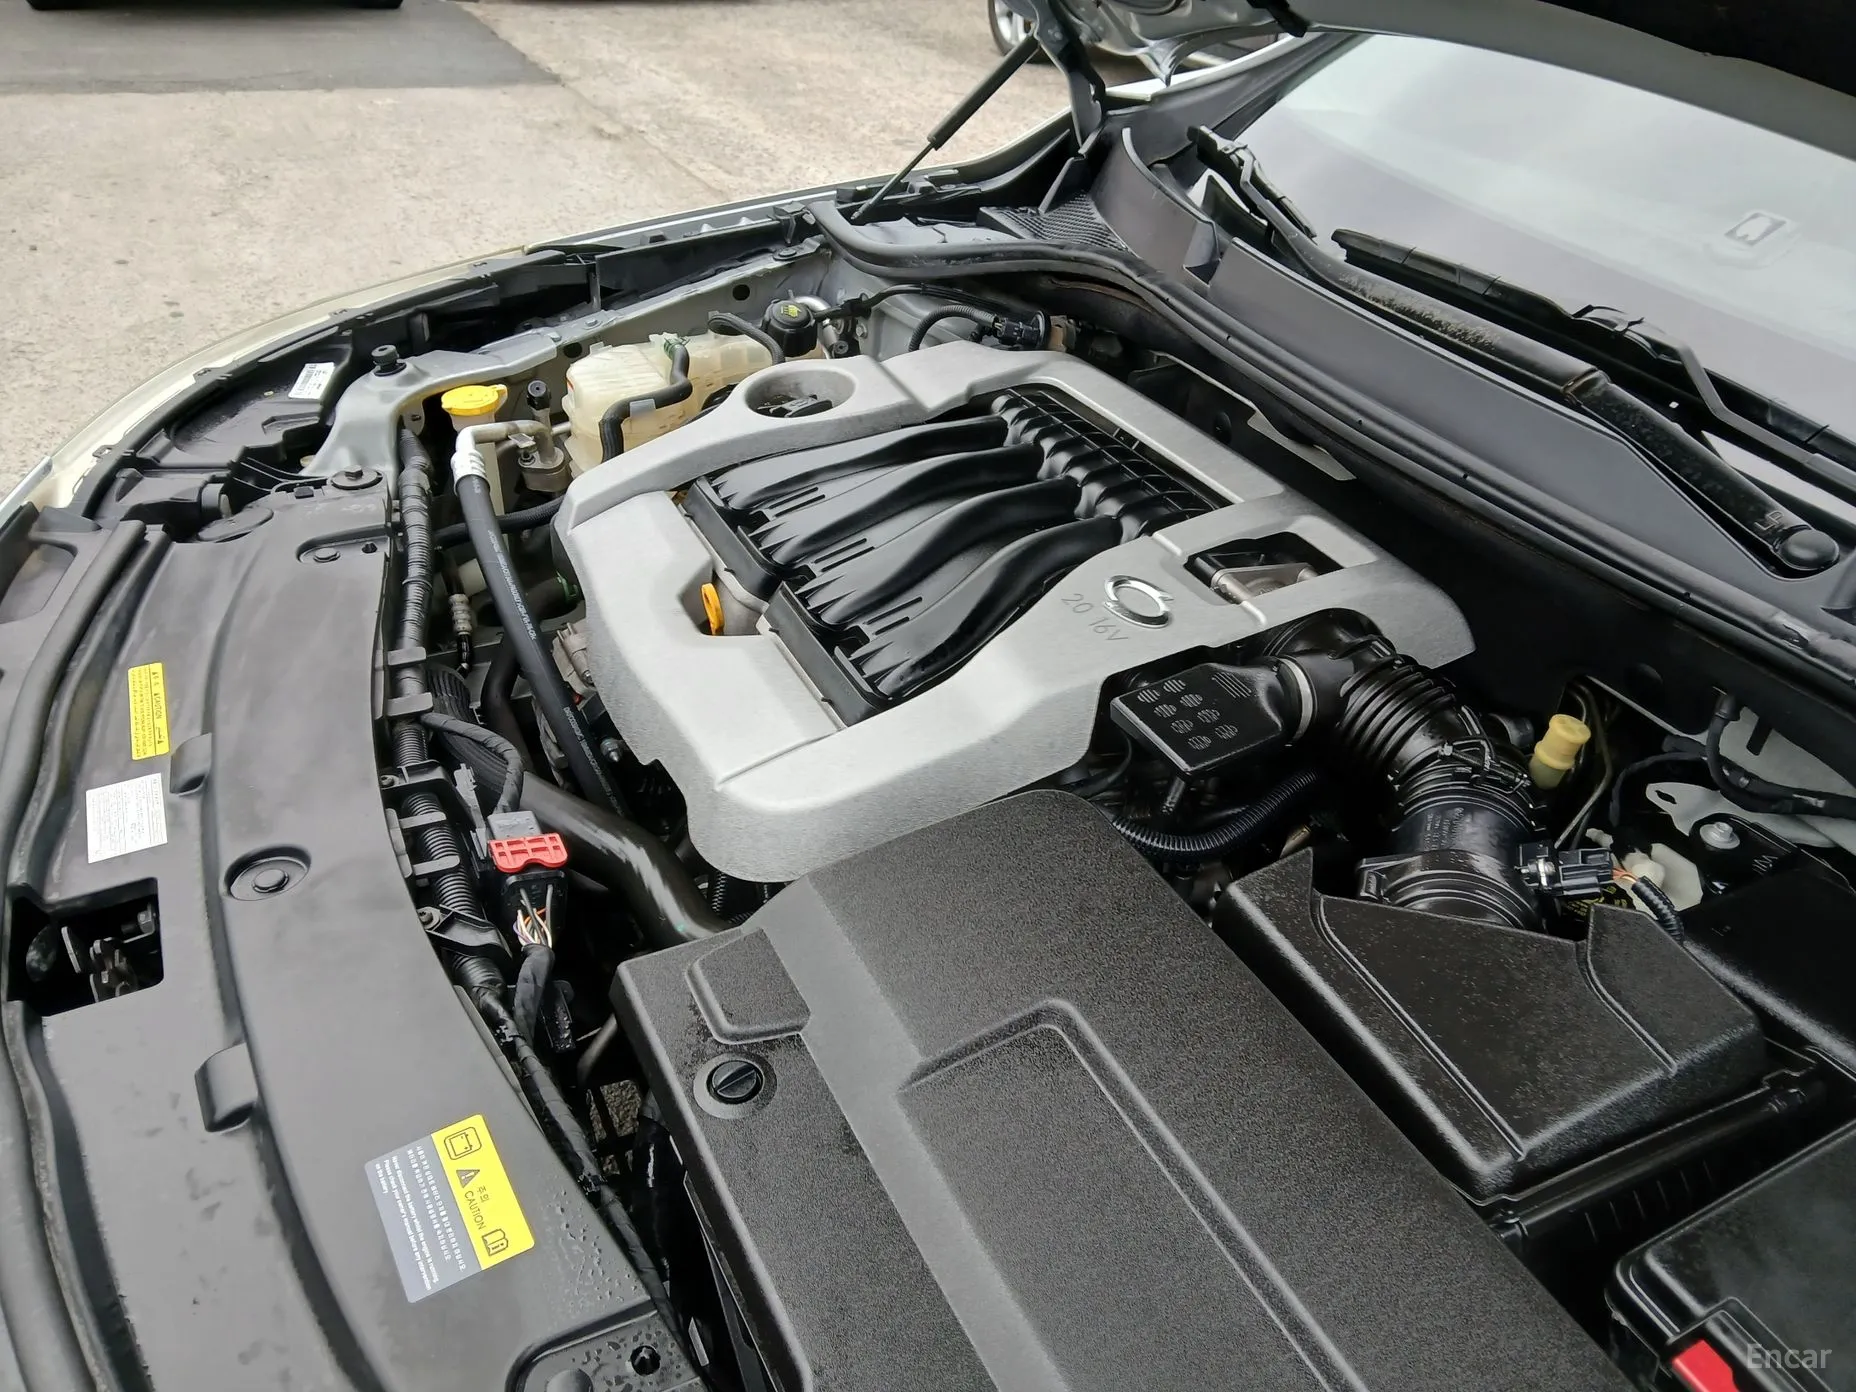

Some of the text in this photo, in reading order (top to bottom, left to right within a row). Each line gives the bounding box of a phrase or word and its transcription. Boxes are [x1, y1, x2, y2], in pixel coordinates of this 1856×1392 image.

[1061, 594, 1129, 640] 20 16V
[383, 1159, 392, 1175] Please
[388, 1175, 397, 1189] check
[391, 1188, 400, 1199] your
[476, 1185, 489, 1203] 주의
[391, 1155, 400, 1169] Never
[396, 1169, 409, 1194] disconnect
[407, 1201, 416, 1219] battery
[412, 1217, 423, 1233] whilst
[420, 1240, 431, 1258] engine
[396, 1199, 406, 1218] owner's
[464, 1190, 486, 1230] CAUTION
[403, 1217, 414, 1235] manual
[408, 1234, 418, 1251] before
[417, 1260, 431, 1290] intervention
